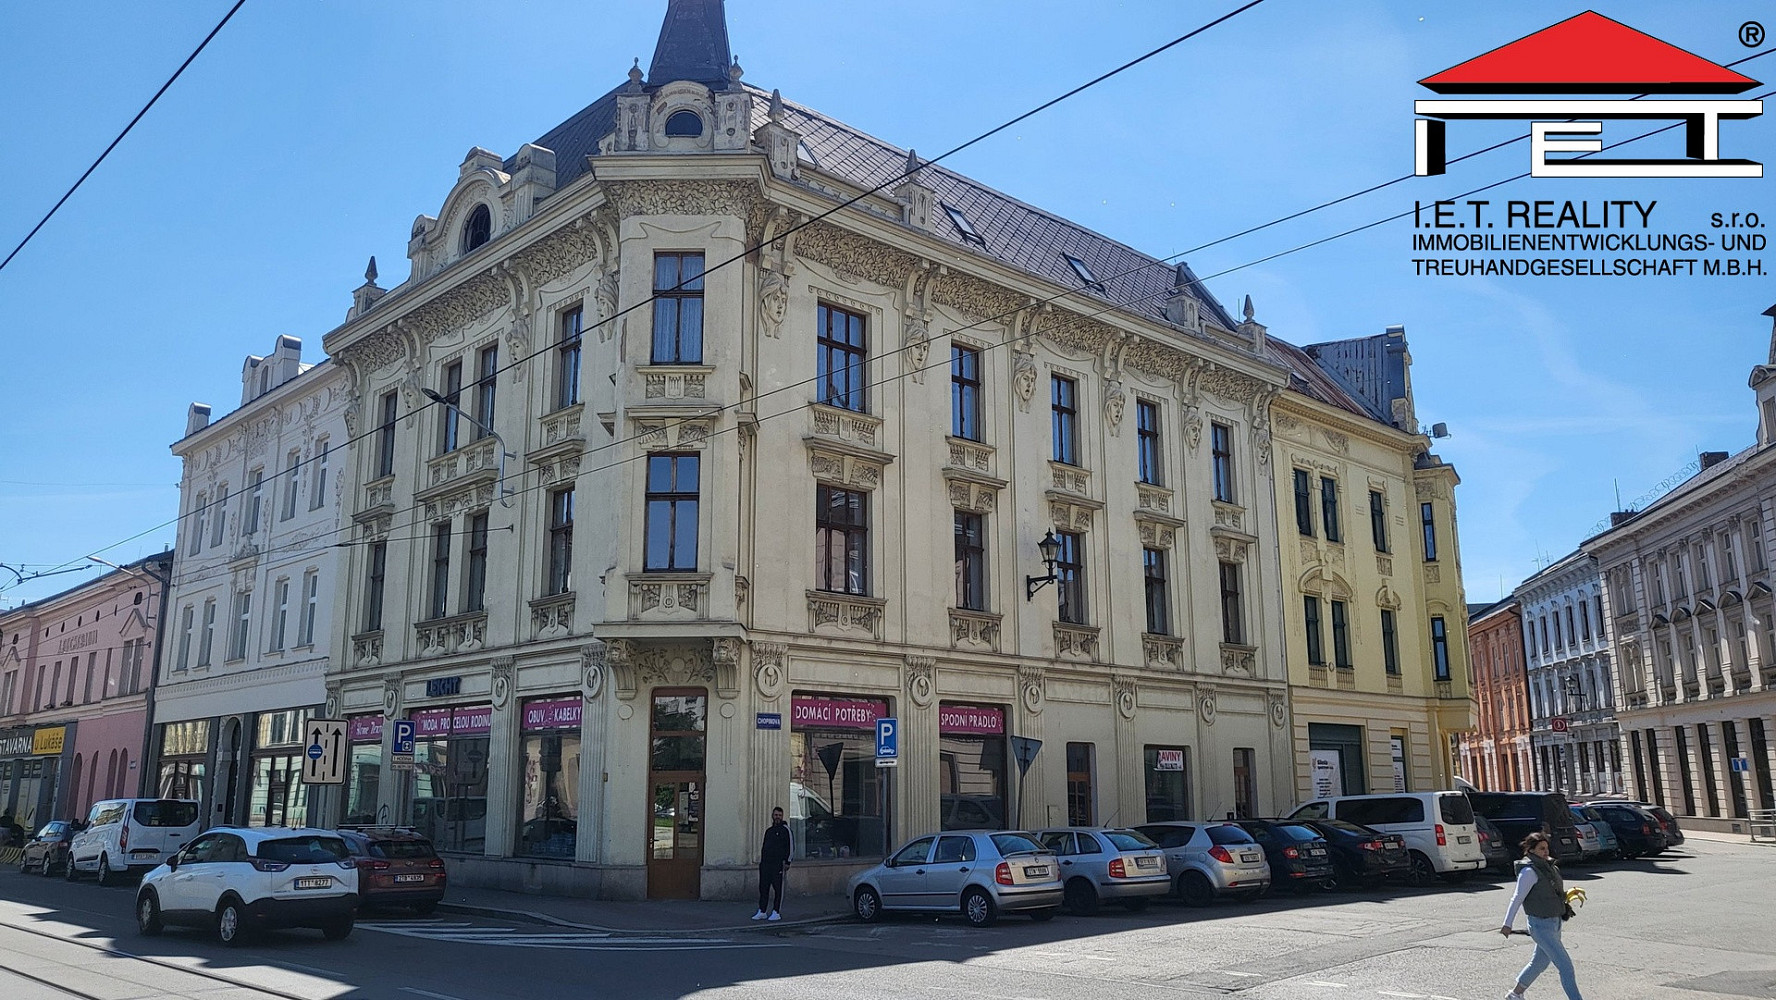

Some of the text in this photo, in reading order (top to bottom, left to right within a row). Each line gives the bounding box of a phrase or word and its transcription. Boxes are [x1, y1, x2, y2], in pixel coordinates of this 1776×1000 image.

[528, 706, 583, 724] OBUV KABELKY
[795, 703, 872, 723] DOMÁCÍ POTŘEBY
[941, 711, 997, 728] SPODNÍ PRÁDLO
[423, 716, 438, 732] MÓDA
[441, 719, 451, 731] PRO
[453, 716, 470, 729] CELOU
[398, 724, 411, 744] P
[881, 723, 893, 745] P
